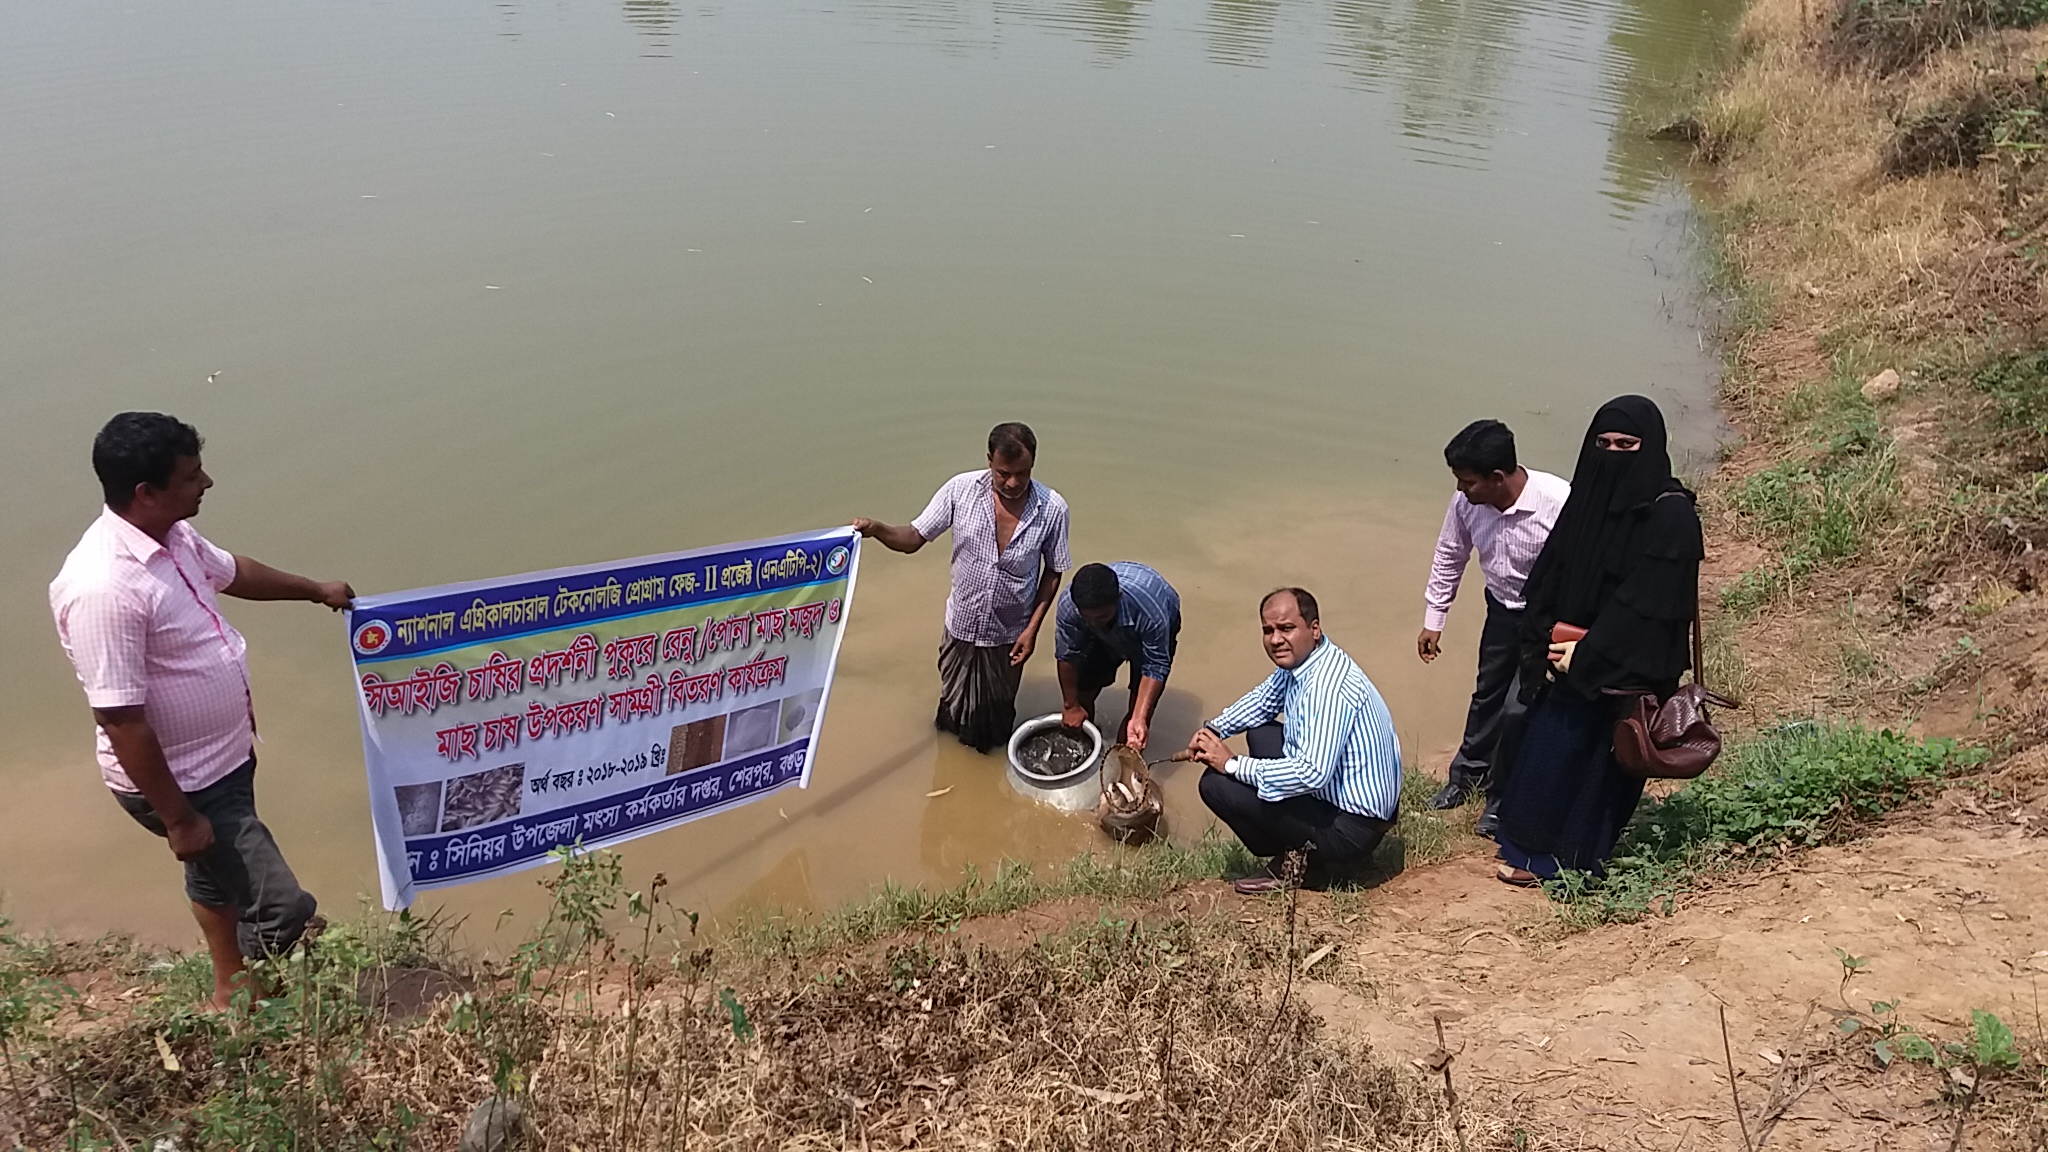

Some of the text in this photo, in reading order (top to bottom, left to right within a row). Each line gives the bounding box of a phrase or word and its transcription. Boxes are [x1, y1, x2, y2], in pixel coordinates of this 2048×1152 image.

[361, 662, 461, 716] সিআইজি
[466, 651, 522, 700] চাষির
[528, 633, 598, 688] প্রদর্শনী
[603, 632, 657, 679] পুকুরে
[755, 606, 785, 642] মাছ
[788, 600, 825, 638] মজুদ
[828, 597, 841, 622] ও
[395, 611, 455, 646] ন্যাশনাল
[459, 597, 550, 633] এগ্রিকালচারাল
[553, 576, 622, 617] টেকনোলজি
[625, 575, 666, 605] প্রোগ্রাম
[435, 650, 788, 761] মাছ চাষ উপকরণ সামগ্রী বিতরণ কার্যক্রম
[445, 833, 507, 870] সিনিয়র
[511, 812, 580, 852] উপজেলা
[582, 804, 622, 834] মৎস্য
[625, 780, 687, 822] কর্মকর্তার
[690, 778, 724, 800] দপ্তর,
[728, 759, 775, 788] শেরপুর,
[779, 749, 807, 774] বগুড়
[530, 769, 551, 796] অর্থ
[552, 771, 575, 792] বছর
[586, 752, 648, 785] ২০১৮-২০১৯
